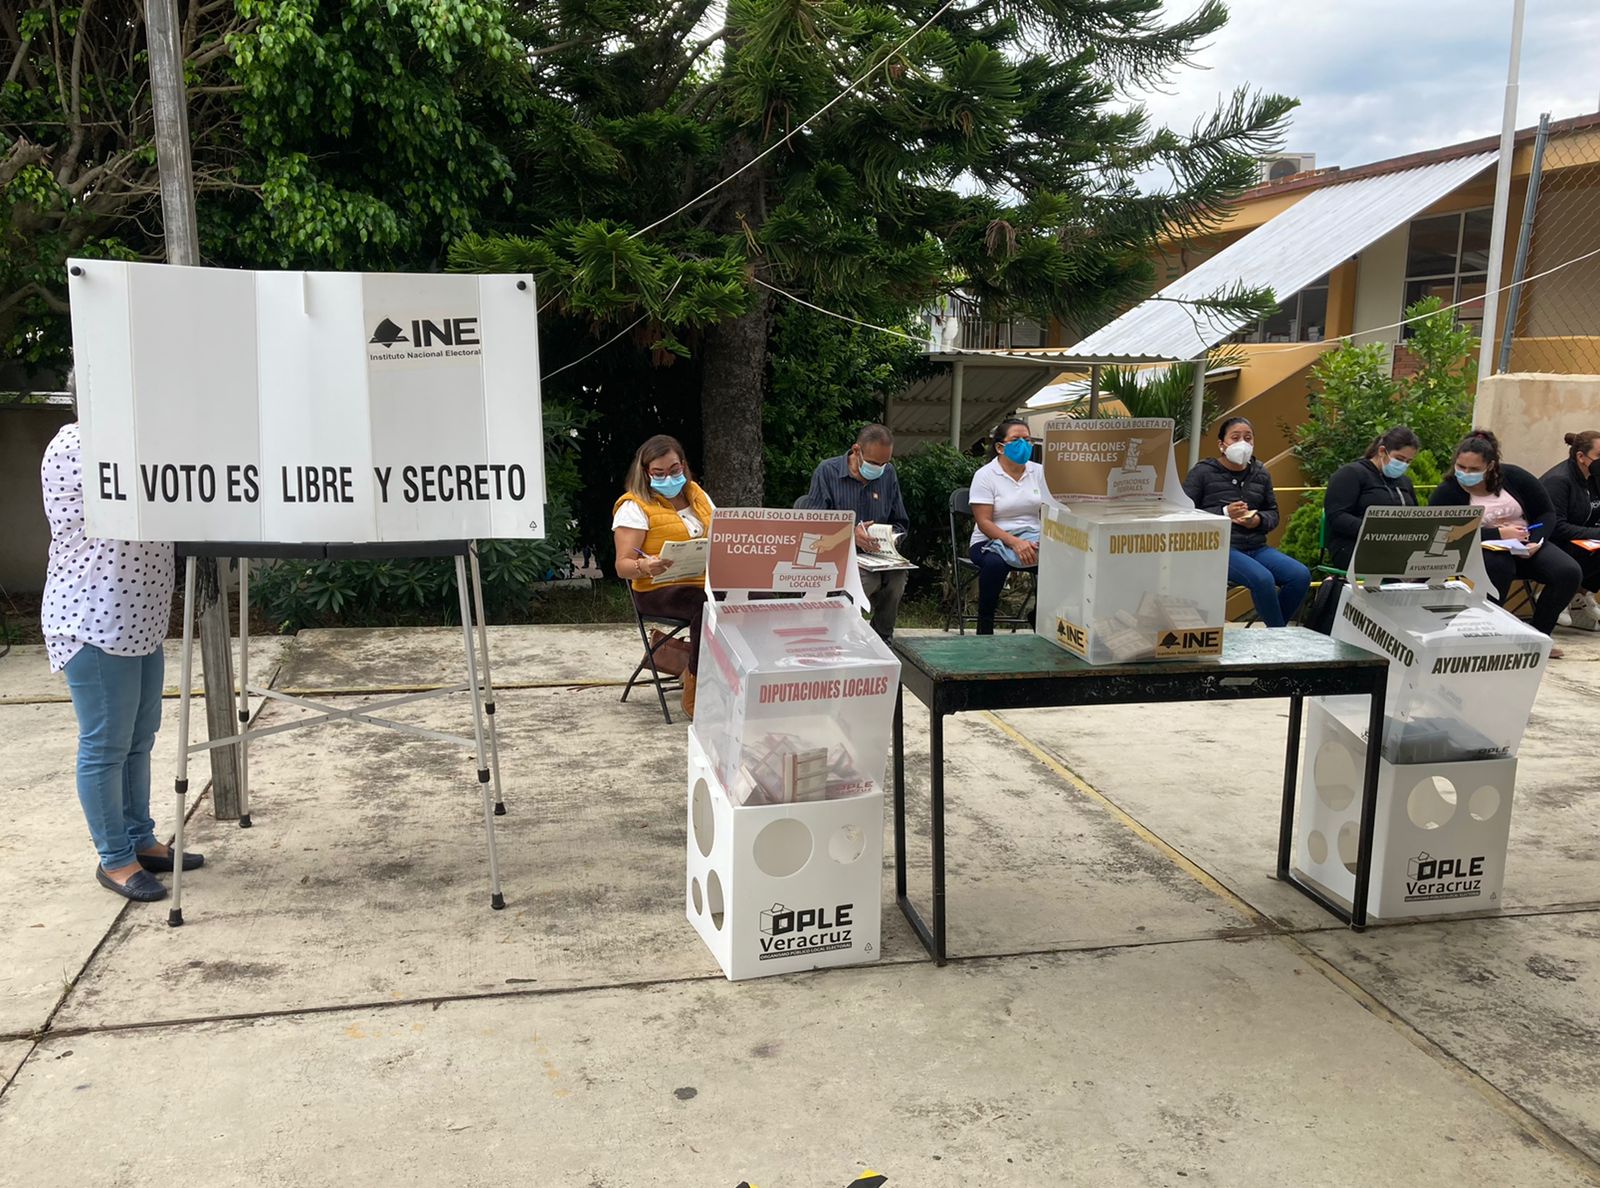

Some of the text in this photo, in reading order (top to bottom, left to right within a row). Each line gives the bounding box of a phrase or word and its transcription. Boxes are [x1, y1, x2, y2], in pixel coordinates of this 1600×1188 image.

[412, 317, 480, 348] INE
[370, 348, 481, 360] Instituto Nacional Electoral
[1047, 420, 1172, 431] META AQUÍ SOLO LA BOLETA DE
[1048, 441, 1126, 452] DIPUTACIONES
[1057, 452, 1118, 462] FEDERALES
[99, 461, 527, 503] EL VOTO ES LIBRE Y SECRETO
[714, 510, 853, 521] META AQUÍ SOLO LA BOLETA DE
[1367, 509, 1390, 517] META
[1391, 508, 1411, 518] AQUÍ
[1444, 509, 1472, 517] BOLETA
[713, 532, 796, 545] DIPUTACIONES
[1109, 532, 1166, 554] DIPUTADOS
[1168, 530, 1220, 552] FEDERALES
[1363, 533, 1429, 542] AYUNTAMIENTO
[727, 544, 777, 555] LOCALES
[1409, 563, 1456, 571] AYUNTAMIENTO
[779, 574, 832, 582] DIPUTACIONES
[1066, 626, 1085, 648] INE
[1182, 631, 1219, 648] INE
[1342, 601, 1414, 667] AYUNTAMIENTO
[1431, 652, 1540, 674] AYUNTAMIENTO
[759, 676, 888, 704] DIPUTACIONES LOCALES
[1417, 856, 1485, 881] OPLE
[1406, 880, 1481, 895] Veracruz
[773, 903, 853, 936] OPLE
[760, 930, 851, 952] Veracruz
